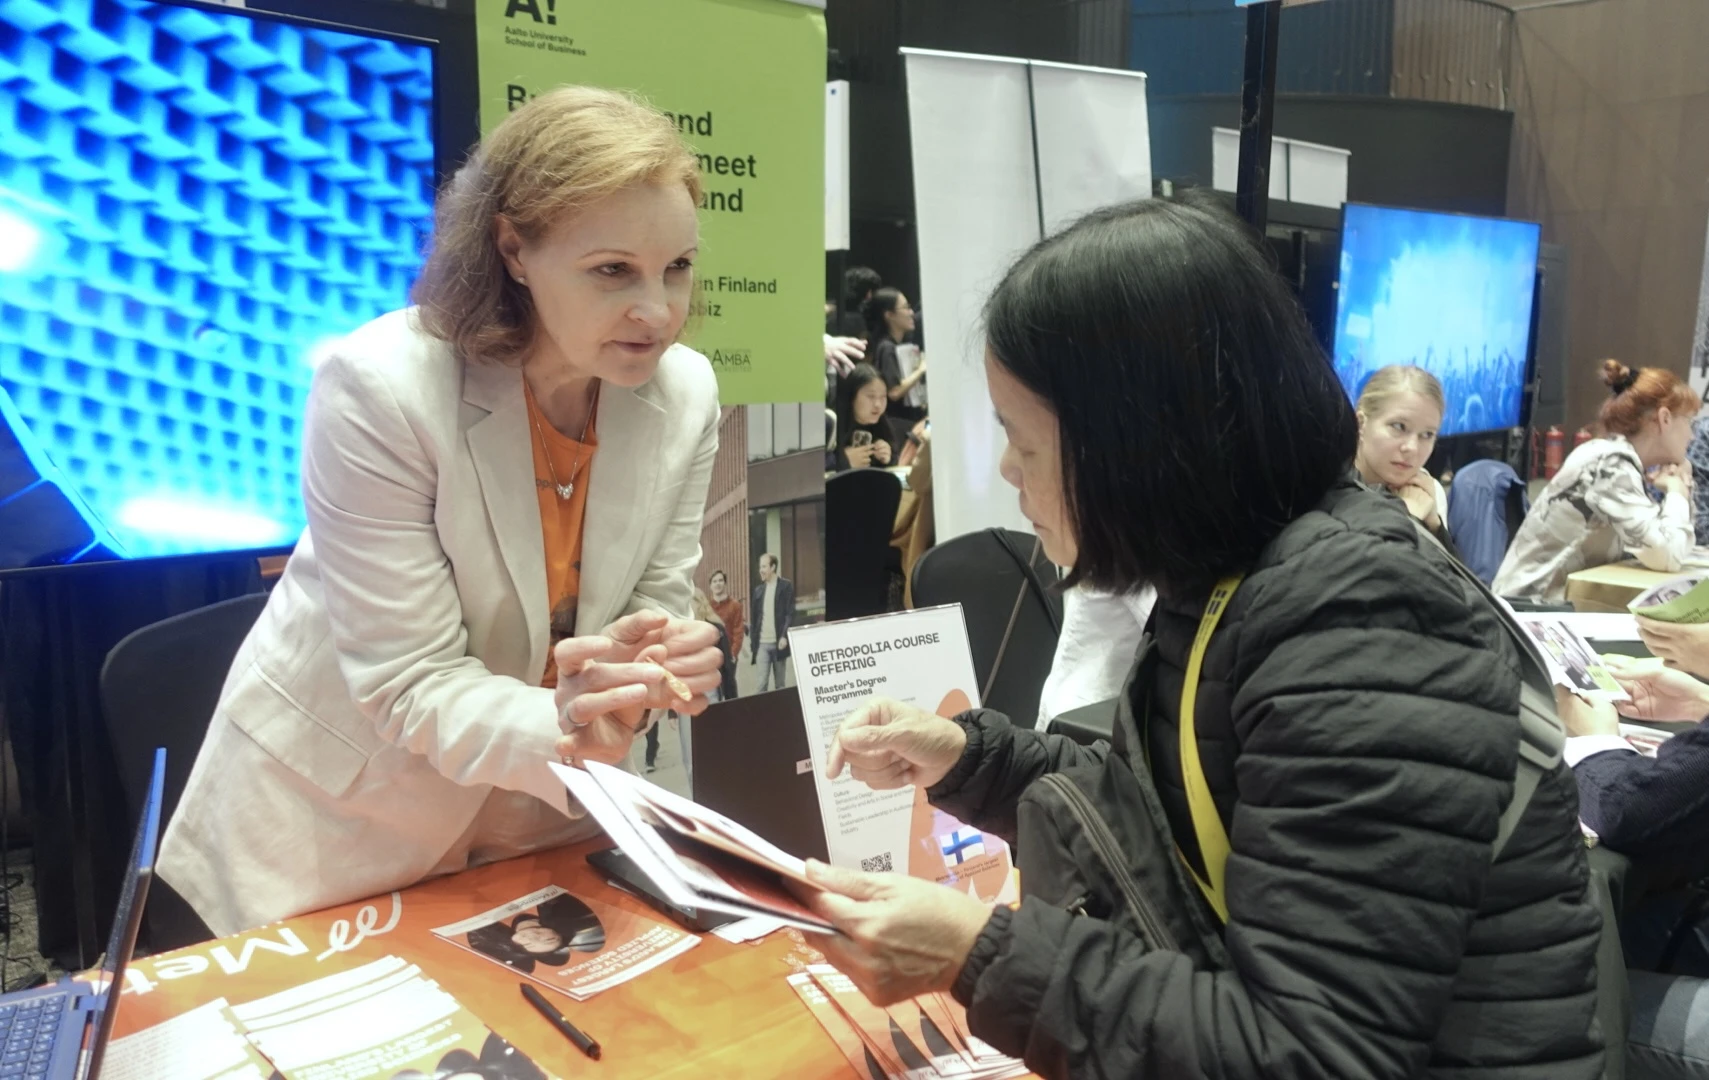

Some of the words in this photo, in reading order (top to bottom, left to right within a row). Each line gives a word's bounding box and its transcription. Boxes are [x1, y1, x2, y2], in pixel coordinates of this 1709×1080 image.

[505, 0, 557, 26] A!
[505, 25, 528, 37] Aalto
[530, 30, 574, 46] University
[505, 36, 535, 49] School
[537, 41, 546, 50] of
[548, 43, 587, 57] Business
[718, 276, 777, 294] Finland
[712, 348, 751, 366] AMBA
[808, 640, 893, 666] METROPOLIA
[893, 632, 941, 651] COURSE
[810, 656, 877, 678] OFFERING
[814, 678, 854, 697] Master's
[855, 675, 888, 692] Degree
[815, 687, 874, 707] Programmes
